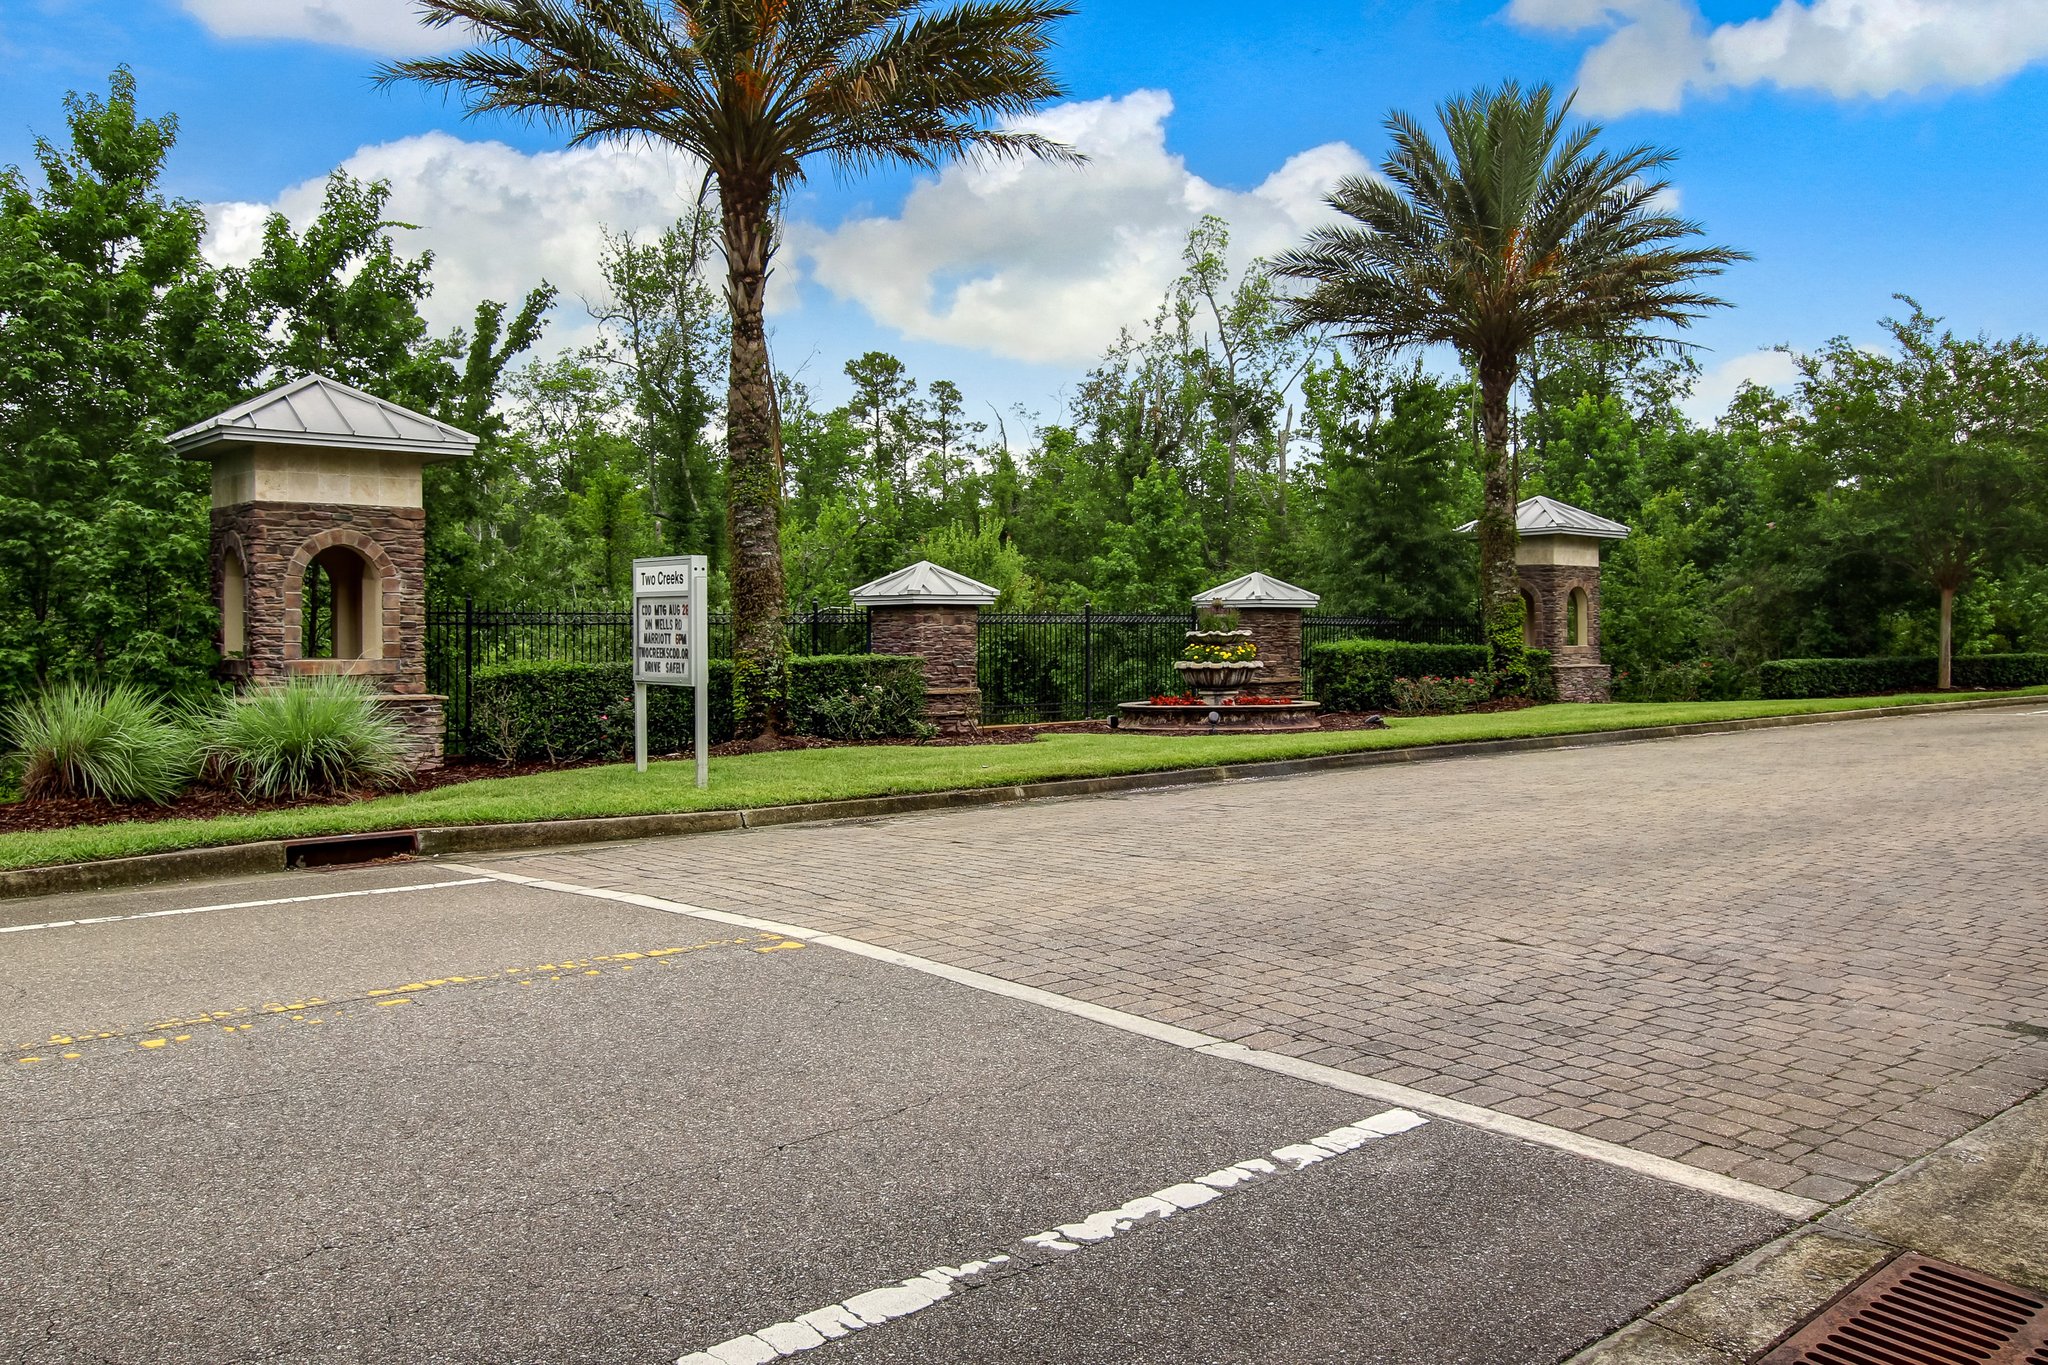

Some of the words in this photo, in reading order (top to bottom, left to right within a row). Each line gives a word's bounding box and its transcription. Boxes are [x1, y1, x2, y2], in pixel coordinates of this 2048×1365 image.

[641, 572, 656, 585] Two
[657, 571, 684, 585] Creeks
[654, 604, 667, 616] MTG
[668, 604, 681, 616] AUG
[655, 619, 673, 630] WELLS
[675, 619, 683, 630] RD
[643, 633, 671, 645] MARRIOTT
[645, 661, 661, 673] DRIVE
[665, 662, 685, 674] SAFELY
